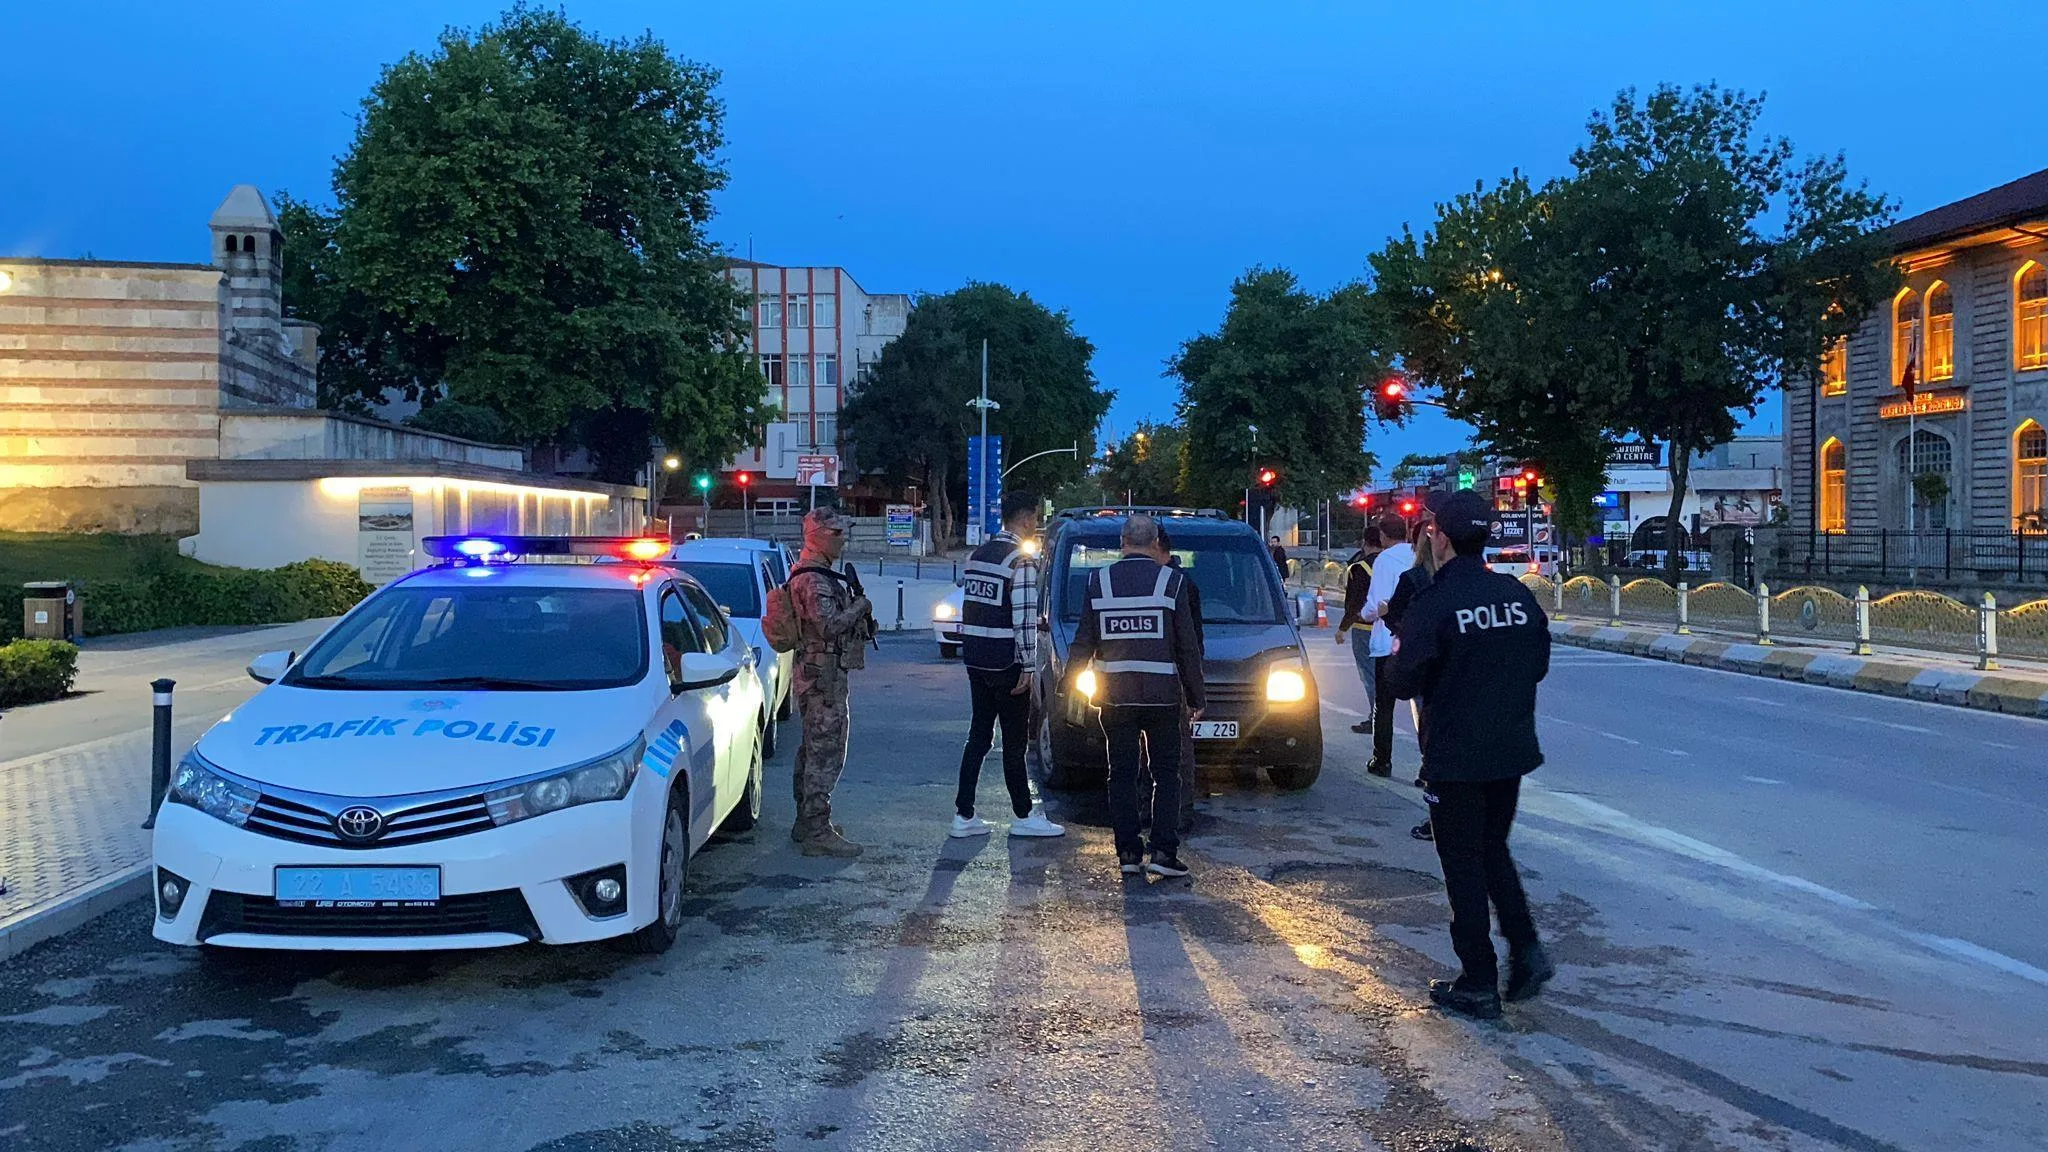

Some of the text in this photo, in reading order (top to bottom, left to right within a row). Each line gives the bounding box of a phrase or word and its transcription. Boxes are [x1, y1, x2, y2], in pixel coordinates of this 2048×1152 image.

[254, 716, 408, 745] TRAFİK
[1213, 723, 1236, 737] 229
[293, 871, 323, 898] 22
